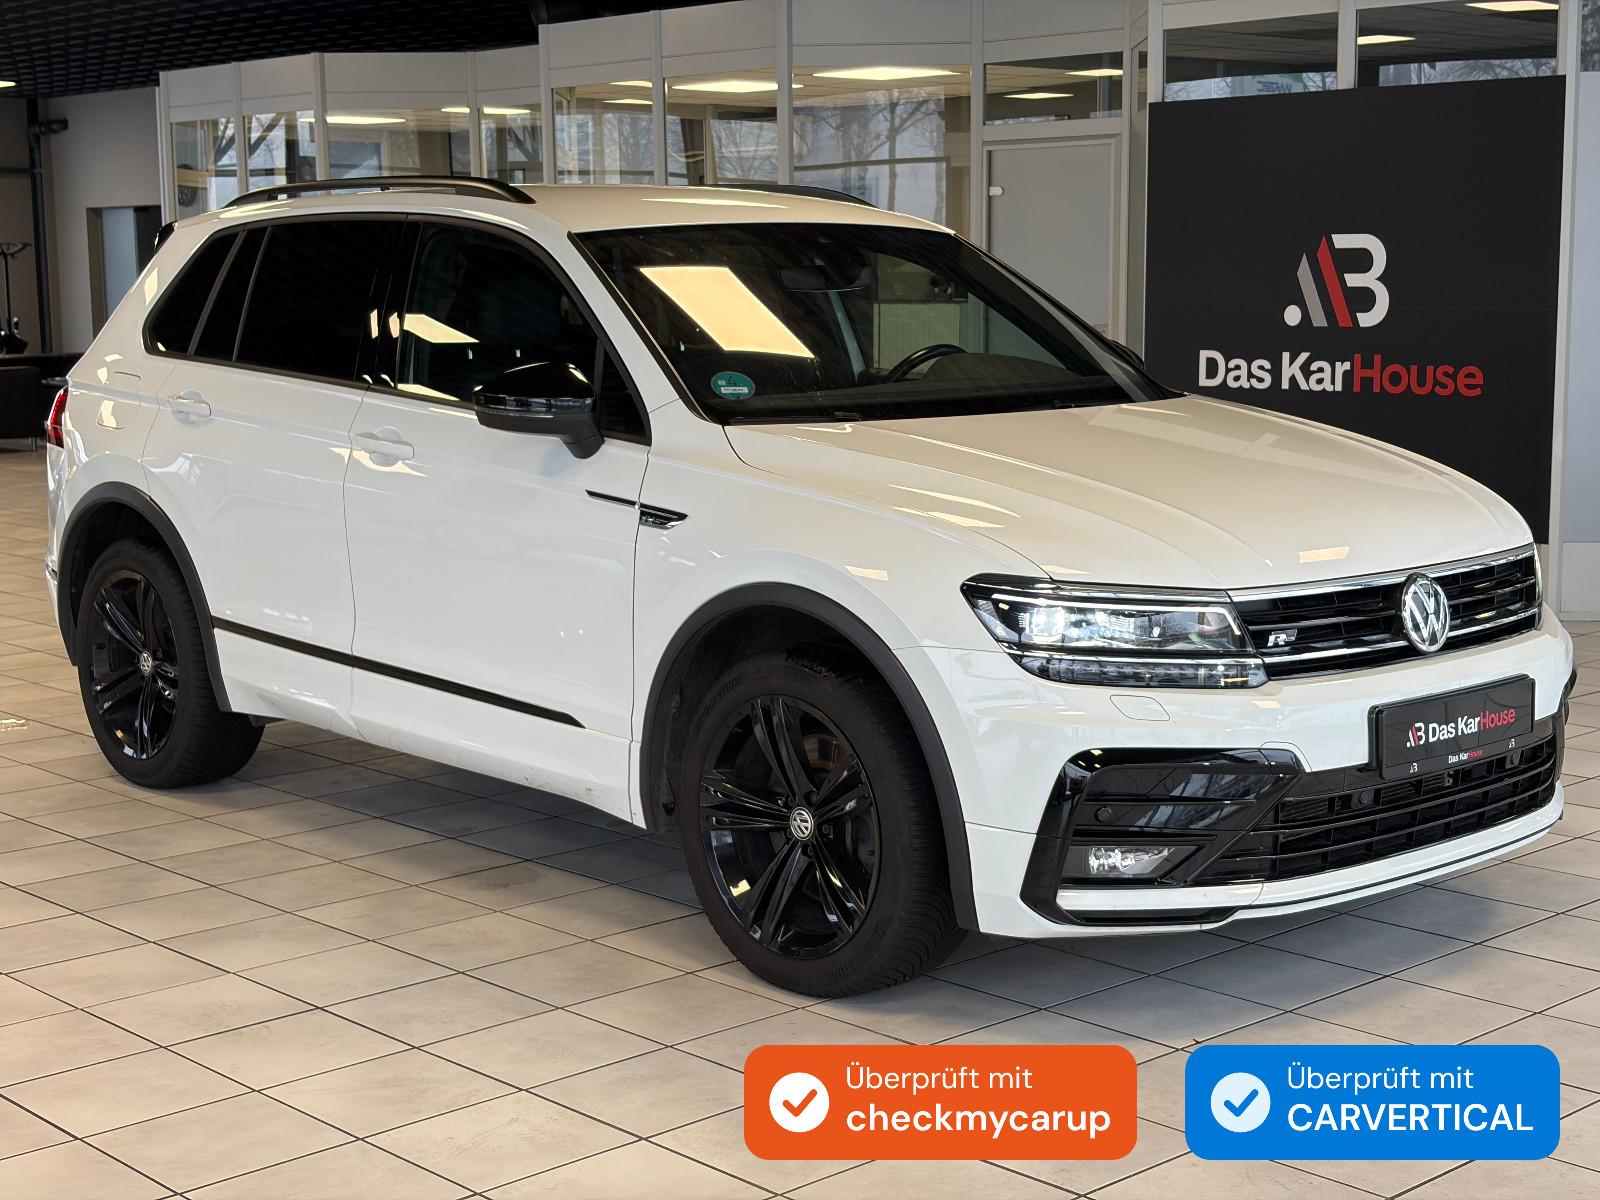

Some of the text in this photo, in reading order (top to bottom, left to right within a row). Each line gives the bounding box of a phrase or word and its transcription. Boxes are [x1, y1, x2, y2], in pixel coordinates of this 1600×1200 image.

[1198, 349, 1484, 397] Das KarHouse
[1428, 722, 1456, 743] Das
[1457, 708, 1516, 737] KarHouse
[1448, 754, 1459, 764] Das
